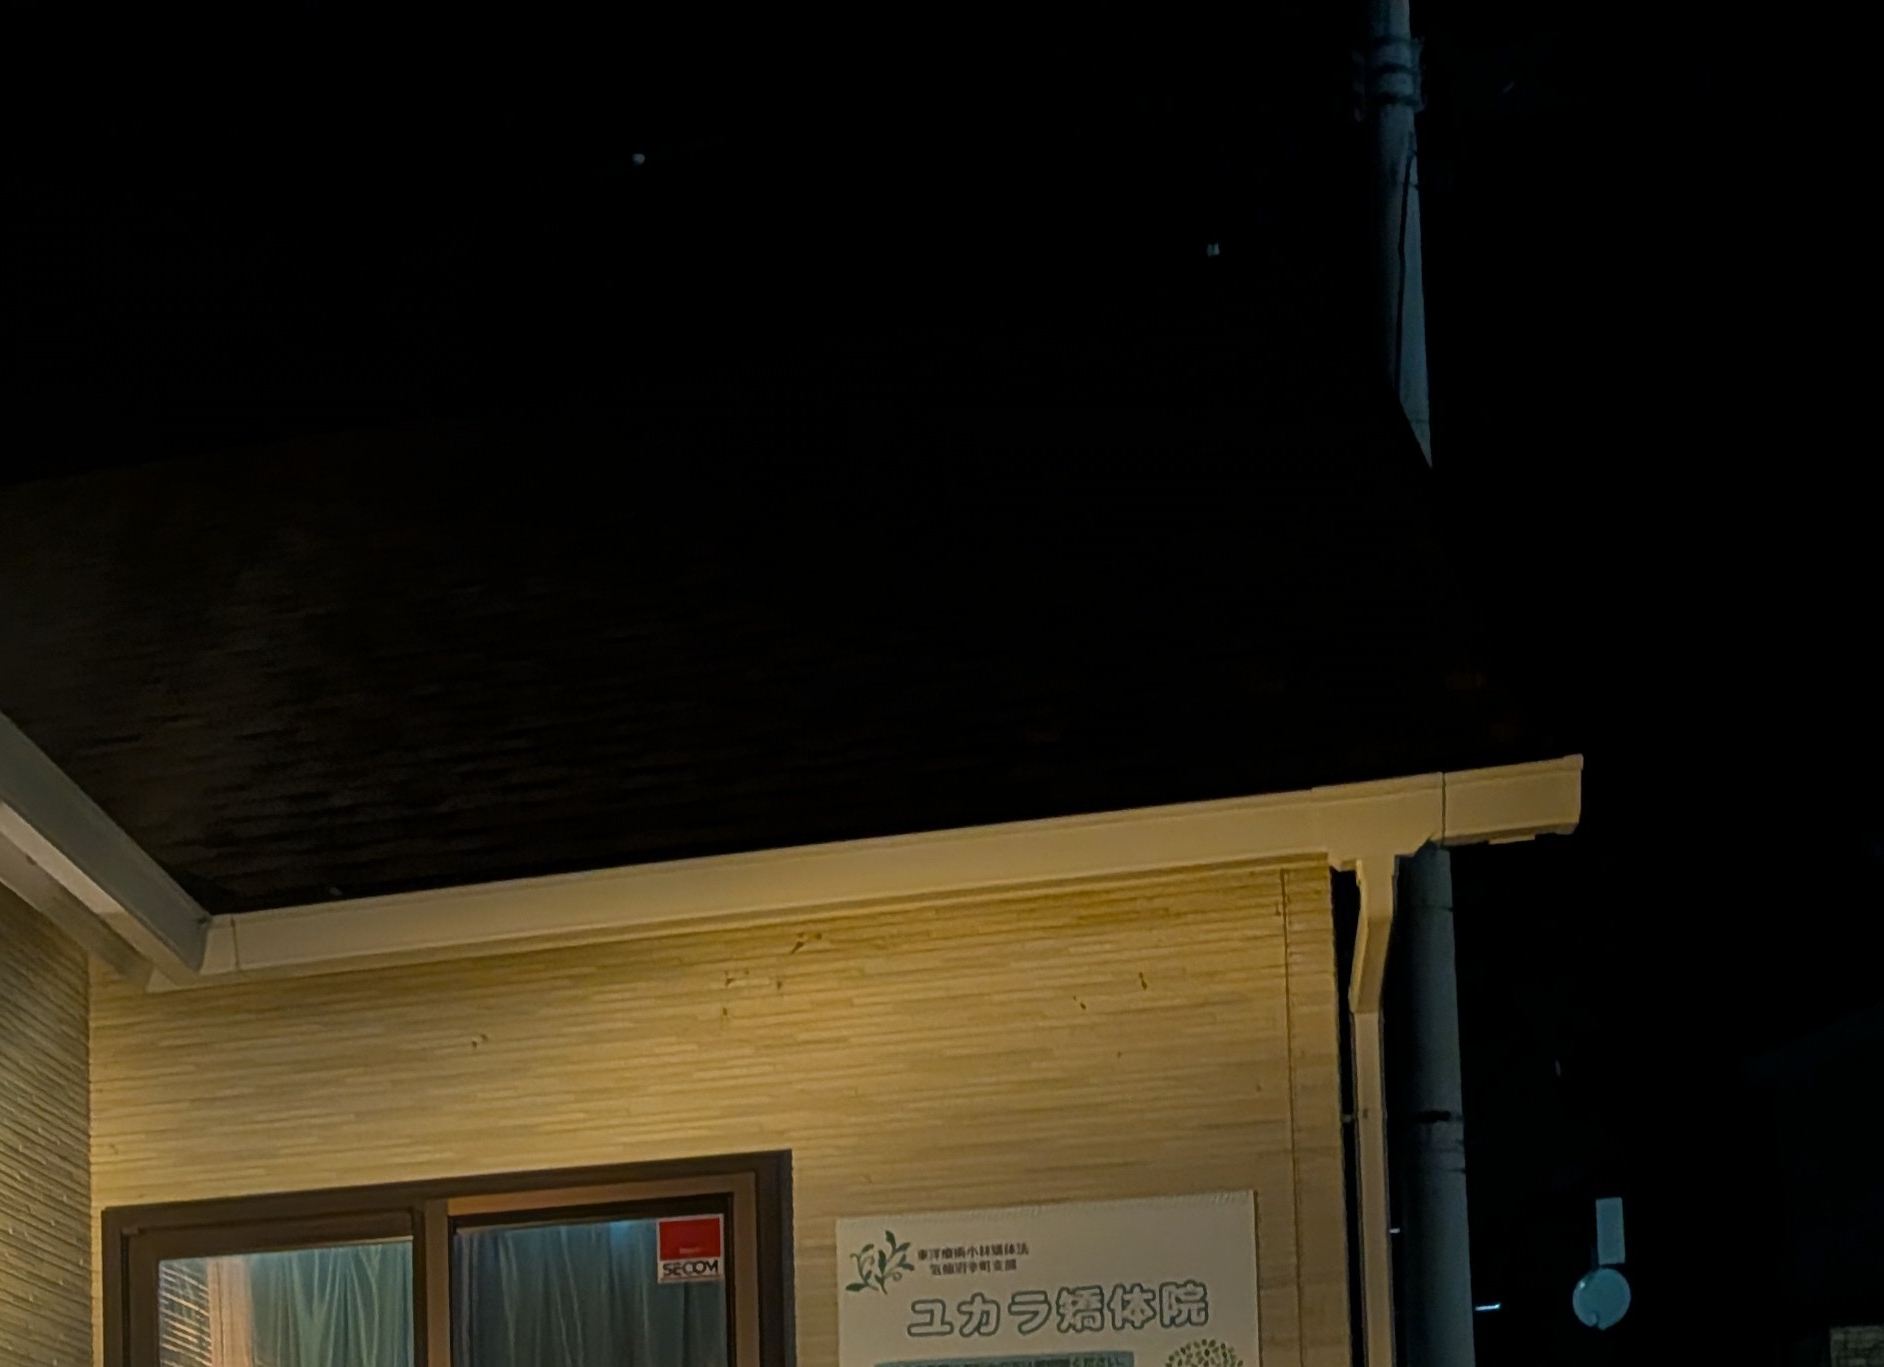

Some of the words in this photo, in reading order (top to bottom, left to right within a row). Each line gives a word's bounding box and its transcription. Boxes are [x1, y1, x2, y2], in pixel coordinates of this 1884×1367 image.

[662, 1259, 719, 1277] SECOM
[907, 1279, 1209, 1338] ユカラ矯体院
